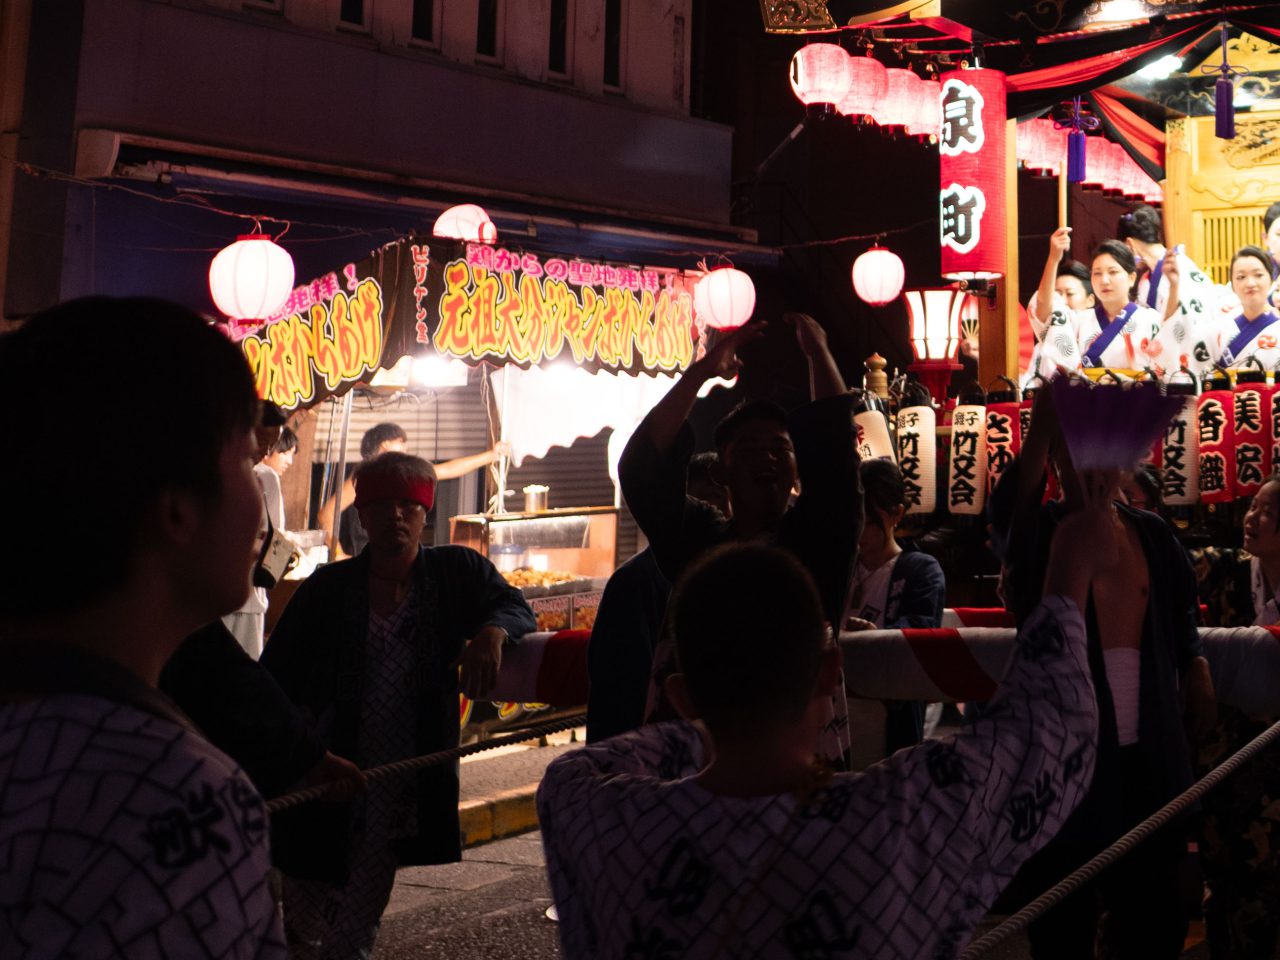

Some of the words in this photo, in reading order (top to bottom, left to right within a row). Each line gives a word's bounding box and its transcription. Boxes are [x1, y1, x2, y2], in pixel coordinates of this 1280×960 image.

[940, 81, 983, 252] 泉町
[900, 431, 923, 506] 竹文会
[951, 430, 980, 506] 竹文会
[1162, 419, 1188, 498] 竹文会
